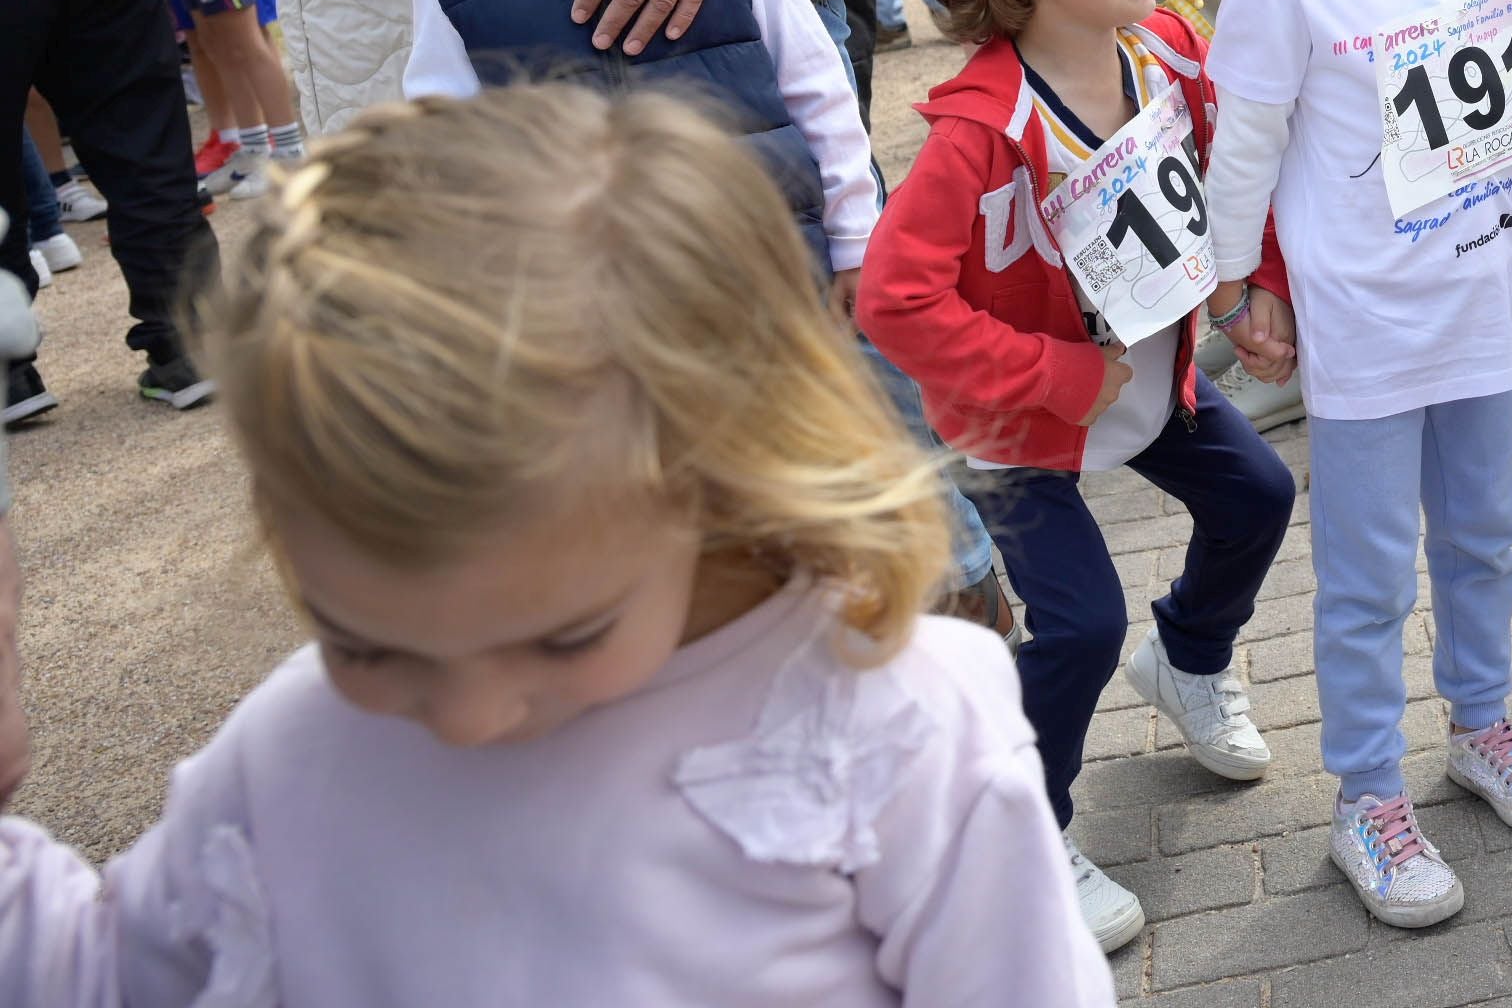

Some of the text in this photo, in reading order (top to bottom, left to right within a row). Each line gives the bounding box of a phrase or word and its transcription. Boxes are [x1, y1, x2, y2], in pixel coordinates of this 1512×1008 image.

[1380, 18, 1441, 52] arrera
[1447, 21, 1474, 40] Sagrada
[1475, 8, 1504, 25] Familia
[1333, 39, 1347, 56] III
[1393, 39, 1446, 71] 2024
[1070, 136, 1139, 200] Carrera
[1465, 147, 1481, 164] LA
[1098, 156, 1148, 207] 2024
[1457, 183, 1501, 211] amilia
[1073, 235, 1103, 263] RESULTADO
